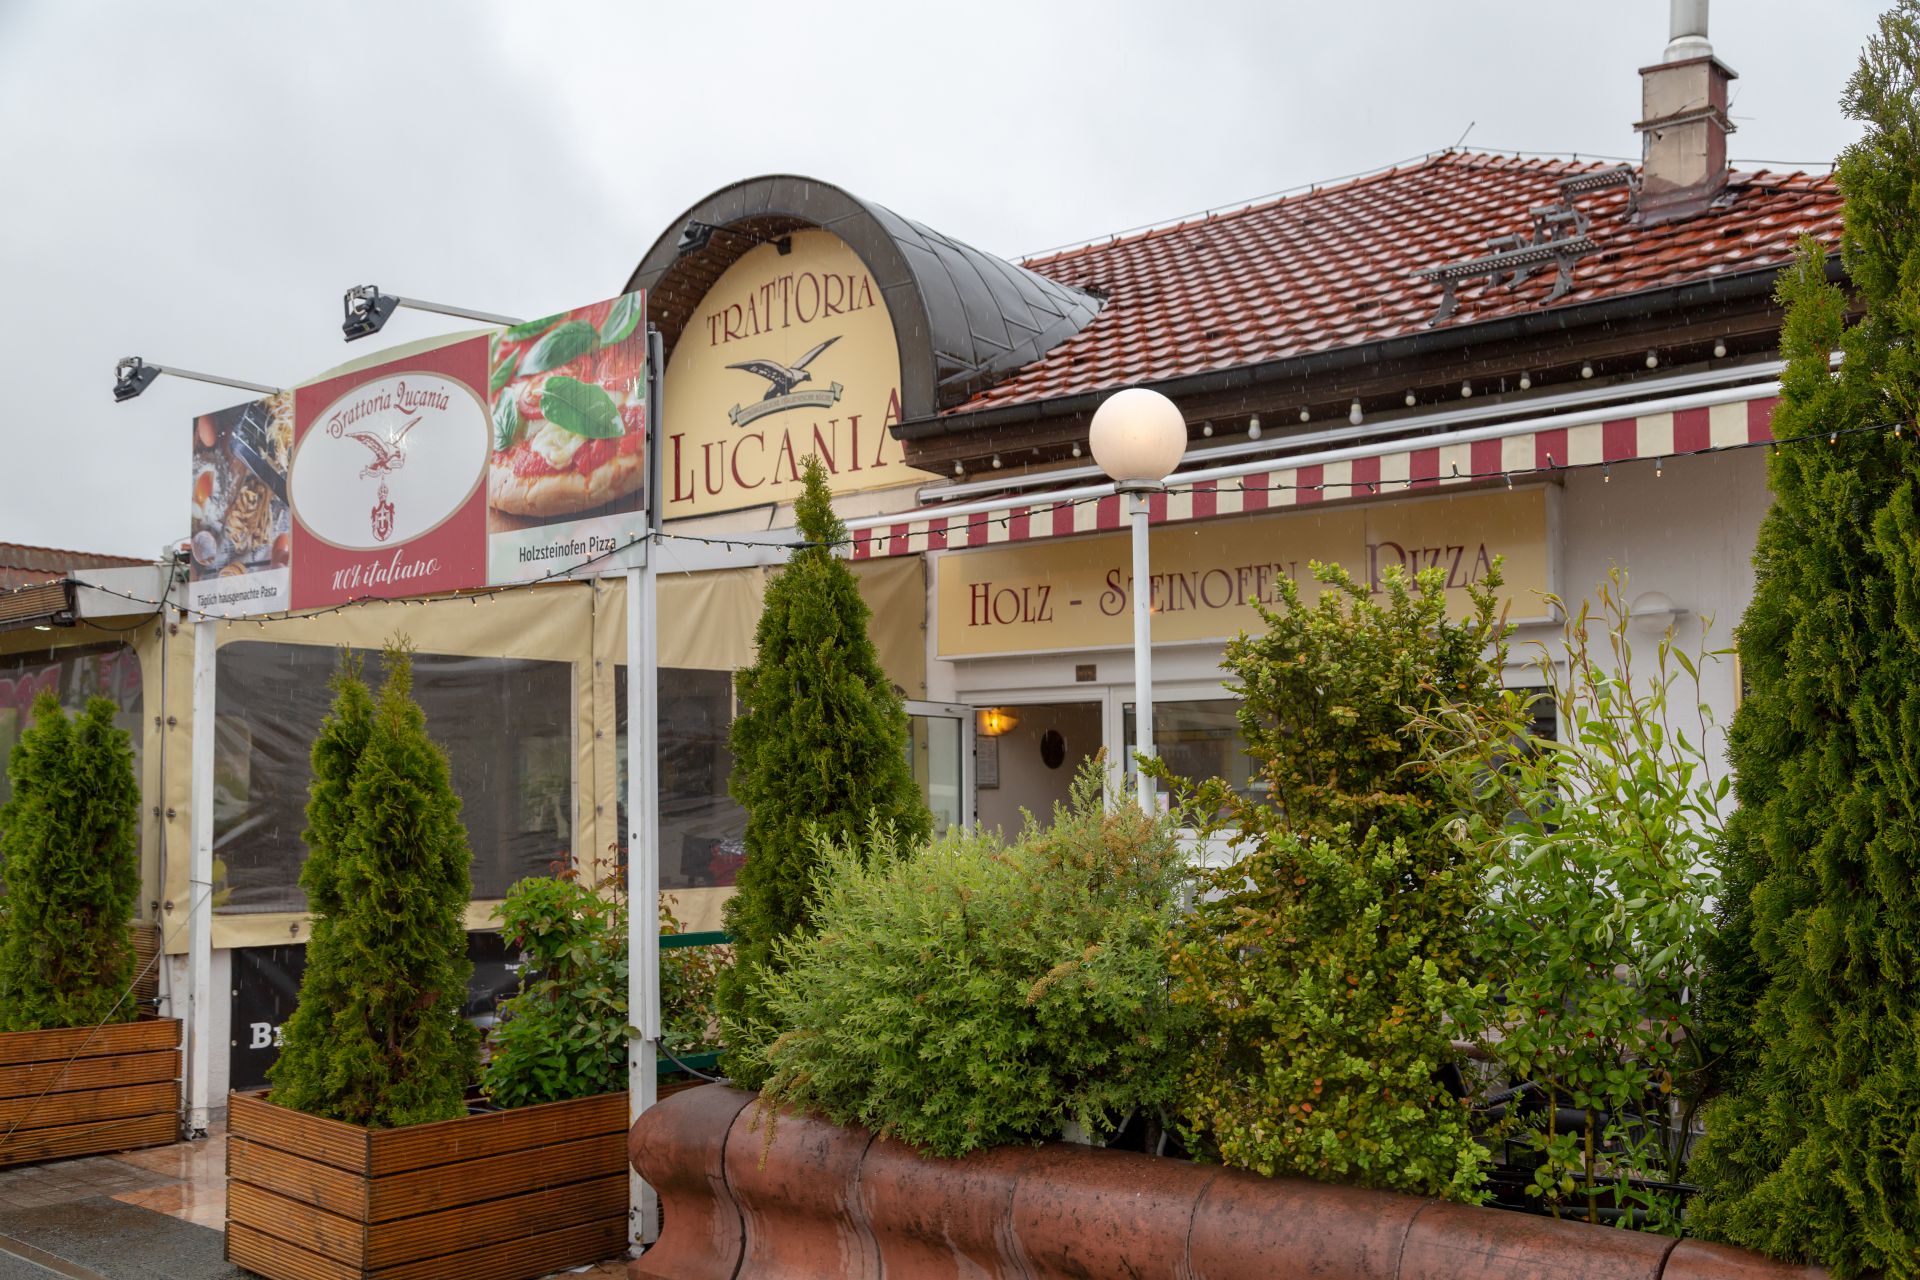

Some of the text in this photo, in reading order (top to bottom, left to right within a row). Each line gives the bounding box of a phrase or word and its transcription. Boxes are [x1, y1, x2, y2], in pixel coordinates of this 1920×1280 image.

[707, 272, 876, 347] TRATTORIA
[326, 381, 450, 439] Trattoria Lucania
[670, 387, 906, 504] LUCANIA
[363, 548, 441, 587] italiano
[519, 535, 616, 562] Holzsteinofen Pizza
[197, 586, 277, 608] Täglich hausgemachte Pasta
[968, 582, 1053, 627] HOLZ
[1100, 561, 1298, 617] SEINOFEN
